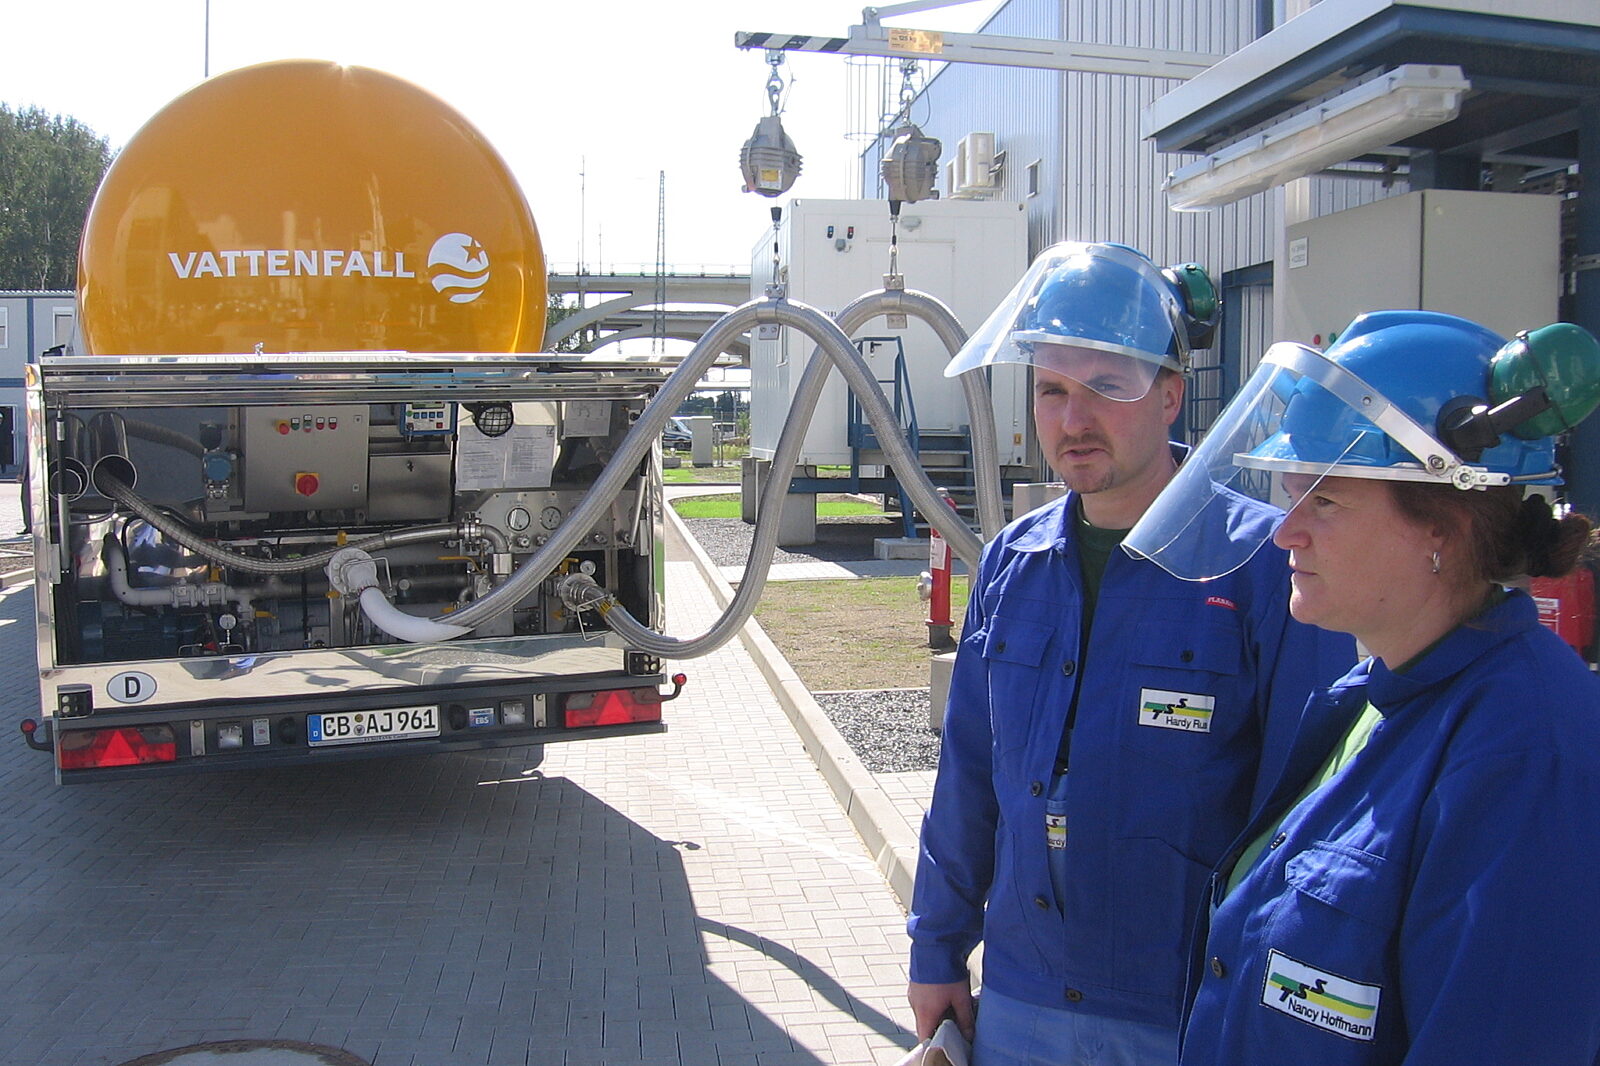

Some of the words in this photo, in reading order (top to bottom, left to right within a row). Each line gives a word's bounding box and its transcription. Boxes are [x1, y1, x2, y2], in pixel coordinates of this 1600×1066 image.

[168, 249, 415, 279] VATTENFALL
[125, 676, 141, 698] D
[1152, 698, 1188, 720] TSS
[323, 716, 351, 737] CB
[366, 712, 393, 734] AJ
[397, 708, 436, 731] 961
[1166, 716, 1192, 729] Hardy
[1279, 978, 1328, 1002] TSS
[1287, 997, 1320, 1022] Nancy
[1320, 1010, 1373, 1036] Hoffmann
